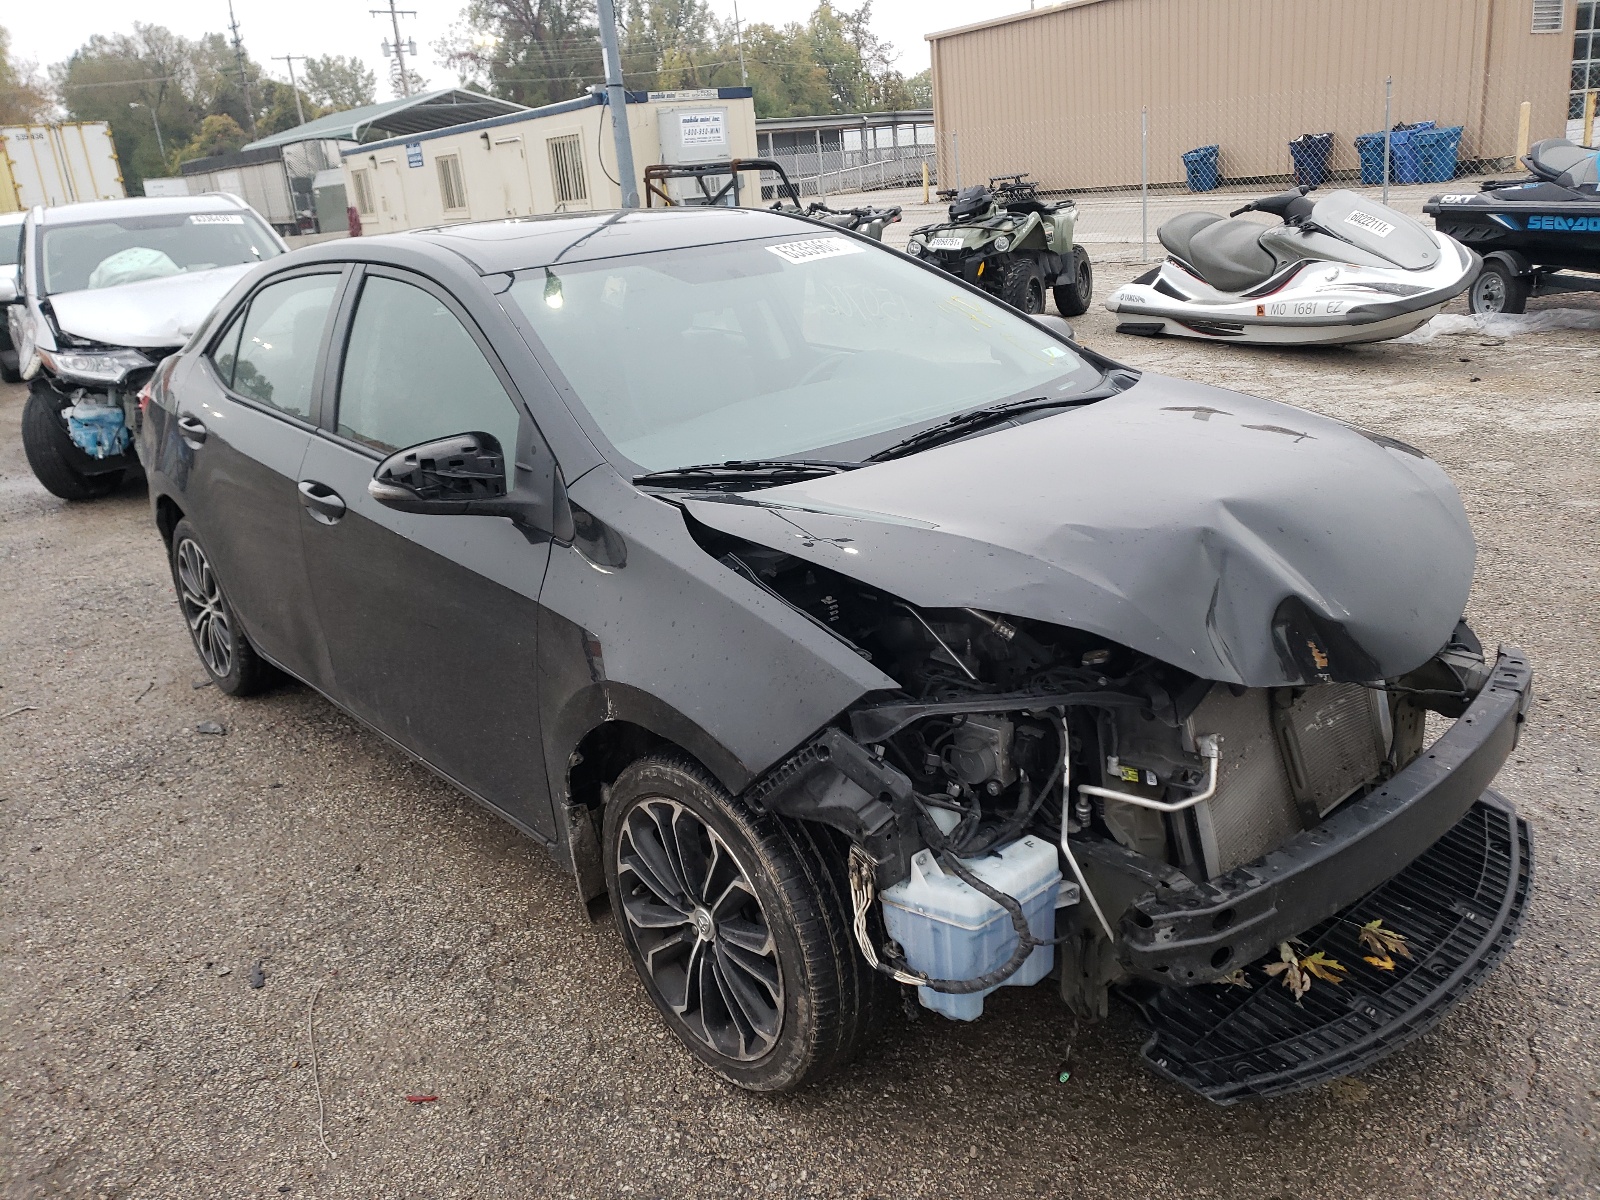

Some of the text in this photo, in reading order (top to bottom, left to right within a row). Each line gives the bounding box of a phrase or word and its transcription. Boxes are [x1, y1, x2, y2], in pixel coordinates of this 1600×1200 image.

[1440, 194, 1478, 204] RXT
[1270, 303, 1287, 316] MO
[1293, 302, 1318, 315] 1681
[1326, 300, 1345, 315] EZ
